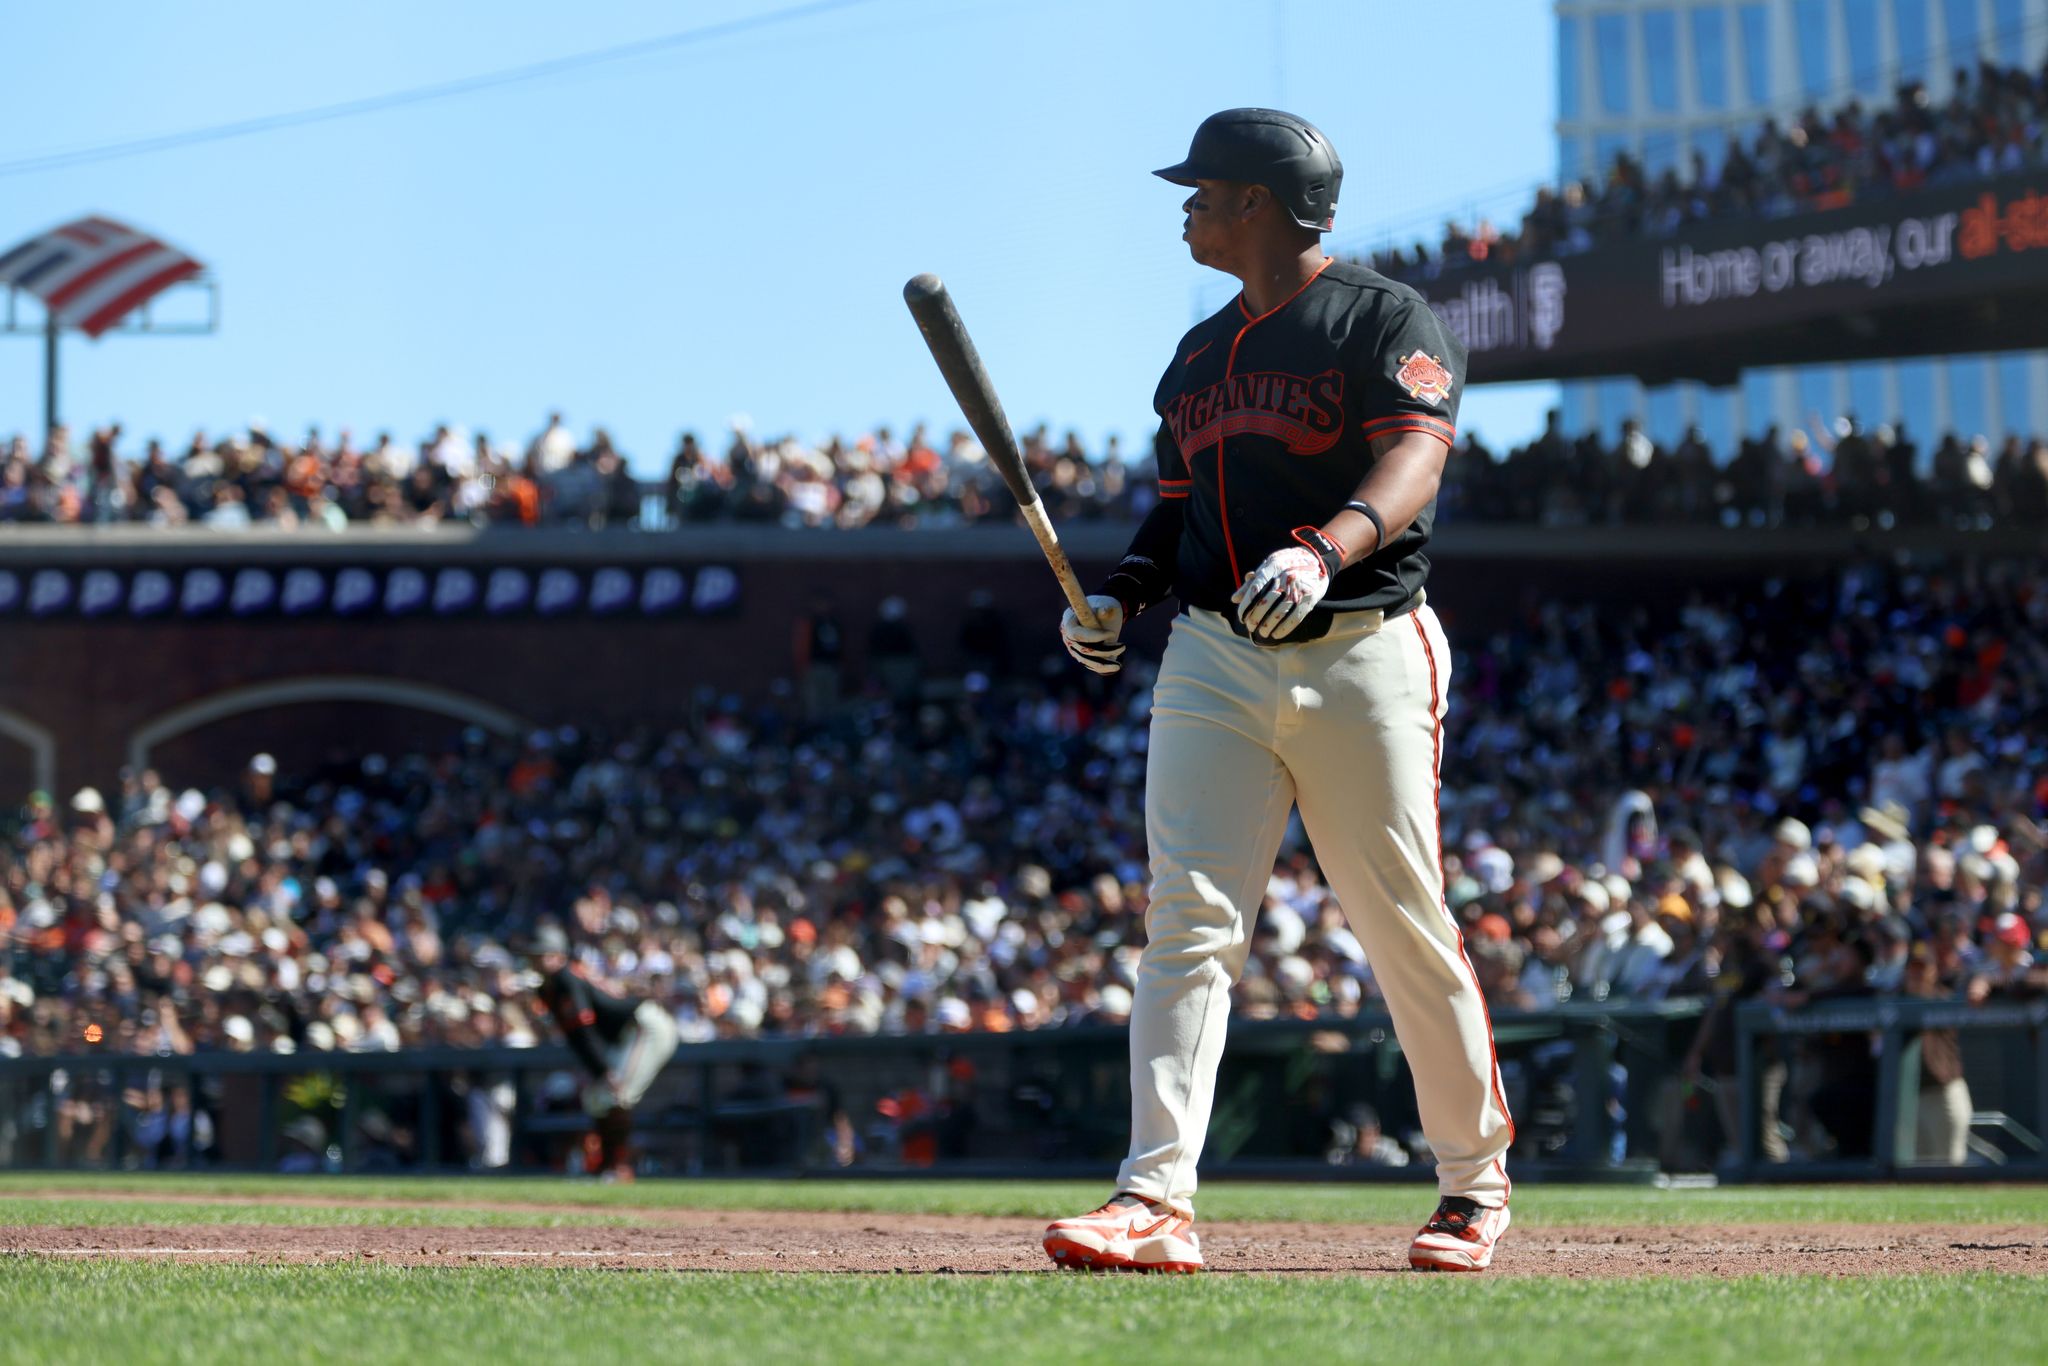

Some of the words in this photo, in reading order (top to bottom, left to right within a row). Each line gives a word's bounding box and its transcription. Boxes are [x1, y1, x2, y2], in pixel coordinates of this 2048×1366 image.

[1661, 244, 1761, 309] Home
[1761, 238, 1799, 292] or
[1801, 225, 1895, 288] away,
[1896, 212, 1958, 269] our
